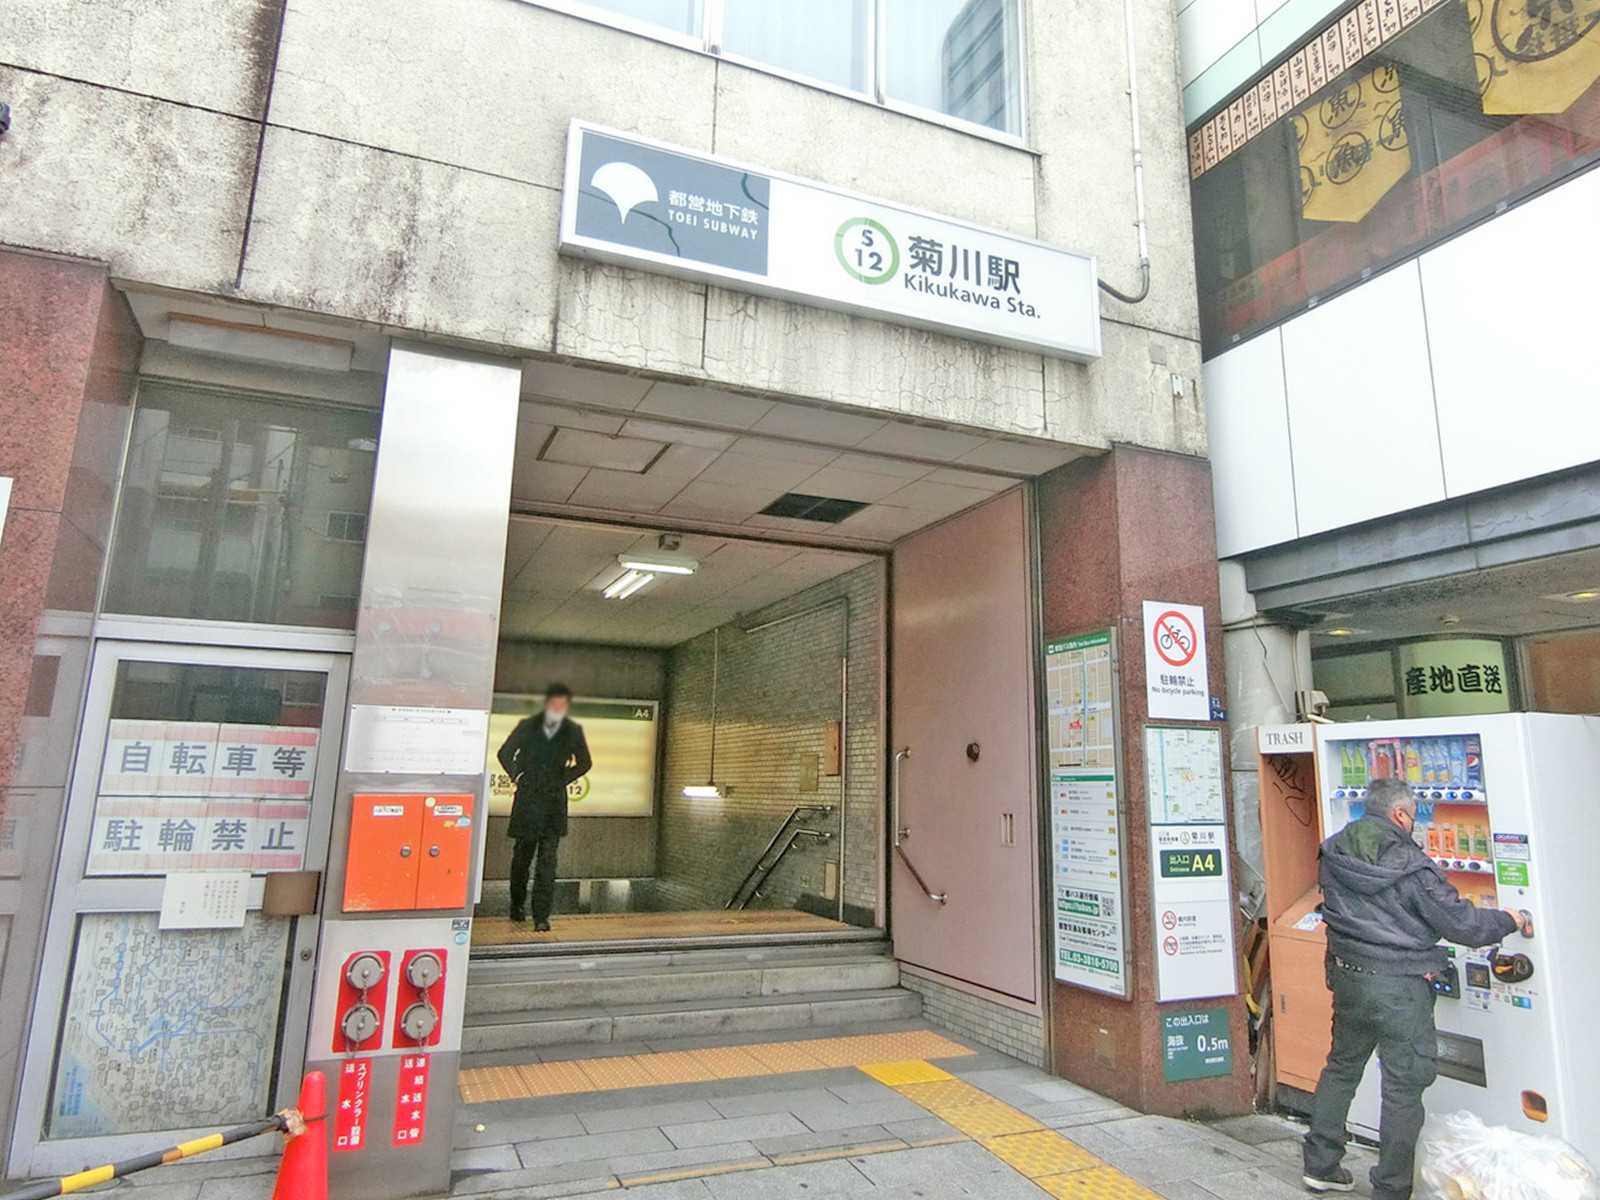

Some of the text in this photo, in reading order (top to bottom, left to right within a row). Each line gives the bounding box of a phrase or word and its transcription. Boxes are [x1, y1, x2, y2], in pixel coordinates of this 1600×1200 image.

[669, 190, 758, 225] 都営地下鉄
[668, 209, 758, 240] TOEI SUBWAY
[862, 229, 874, 247] S
[855, 248, 883, 272] 12
[908, 235, 1021, 295] 菊川駅
[904, 273, 1042, 319] Kikukawa Sta.
[1160, 674, 1195, 687] 駐輪禁止
[1405, 664, 1503, 696] 産地直送
[1162, 687, 1182, 695] bicycle
[1183, 689, 1205, 697] parking
[635, 709, 650, 718] A4
[1266, 732, 1304, 746] TRASH
[120, 741, 307, 778] 自転車等
[569, 786, 583, 795] 12
[103, 819, 296, 852] 駐輪禁止
[1192, 854, 1215, 872] A4
[1166, 1014, 1209, 1028] この出入口は
[1197, 1035, 1229, 1052] 0.5m
